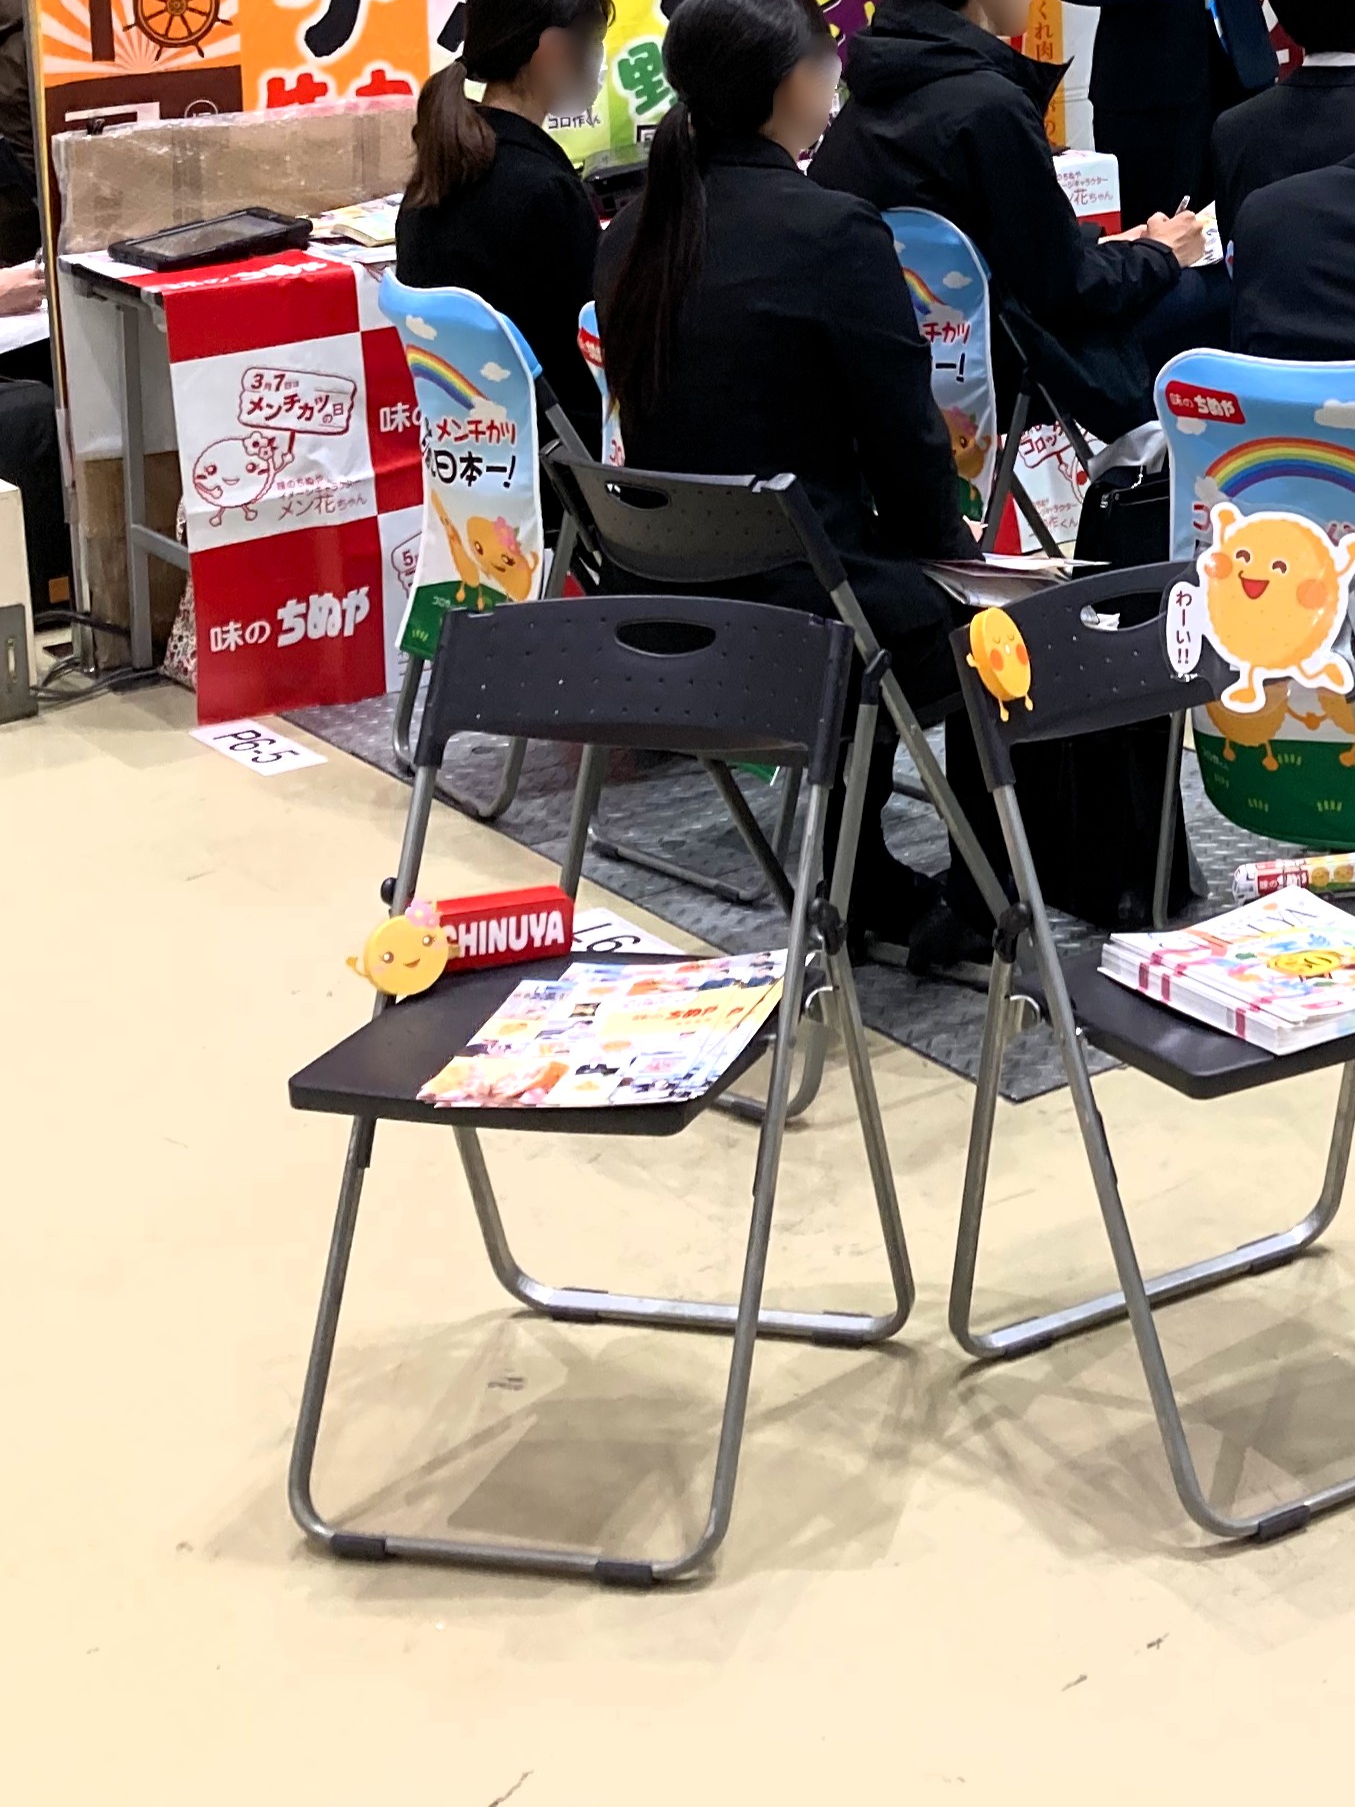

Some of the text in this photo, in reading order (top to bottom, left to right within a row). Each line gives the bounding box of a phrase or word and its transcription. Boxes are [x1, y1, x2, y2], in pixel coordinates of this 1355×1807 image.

[251, 373, 299, 393] 3月7日は
[247, 393, 344, 425] メンチカツの日
[1170, 393, 1235, 417] 味のちぬや
[436, 418, 516, 445] メンチカツ
[278, 493, 367, 521] メン花ちゃん
[209, 585, 371, 654] 味のちぬや
[1176, 590, 1192, 664] わーい!!
[212, 727, 302, 767] P6-5
